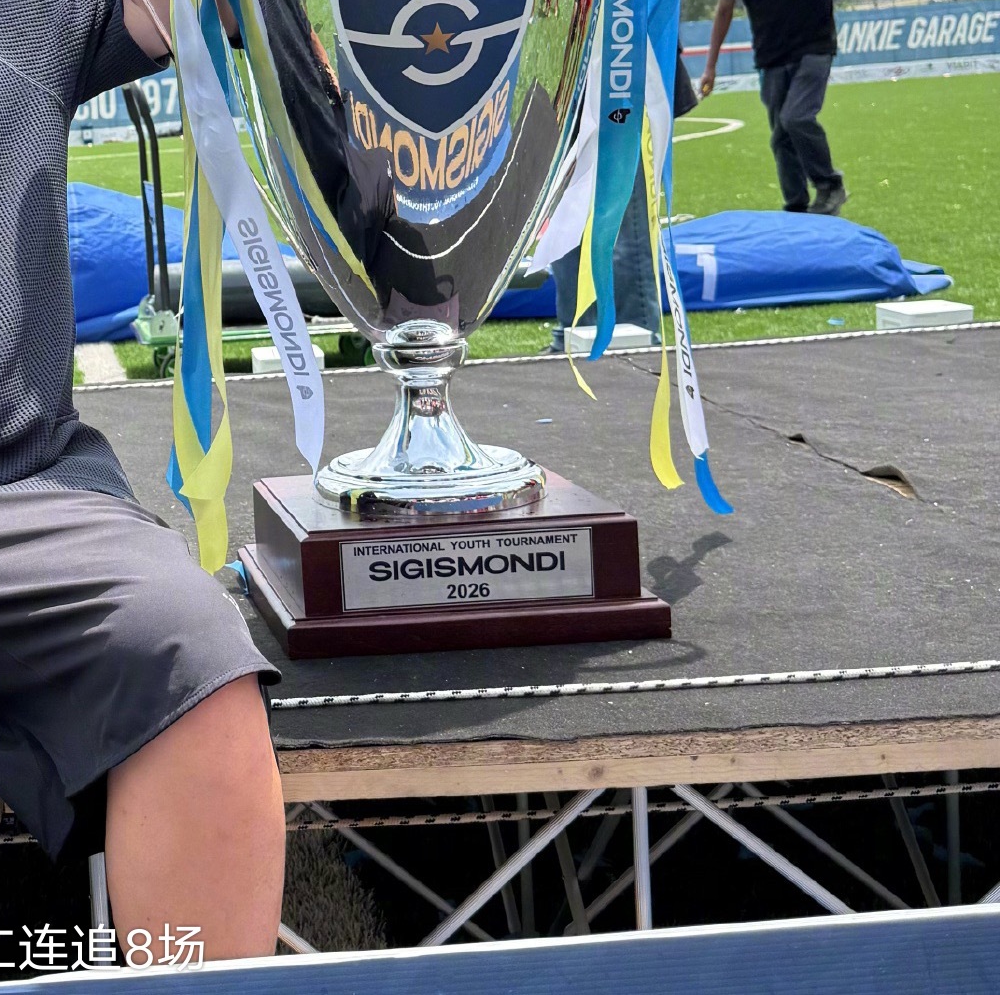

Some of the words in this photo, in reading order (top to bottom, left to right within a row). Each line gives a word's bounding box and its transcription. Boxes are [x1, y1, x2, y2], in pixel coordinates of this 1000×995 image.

[837, 18, 906, 54] ANKIE
[907, 10, 1000, 49] GARAGE
[137, 77, 179, 117] 97
[353, 542, 445, 557] INTERNATIONAL
[450, 539, 491, 551] YOUTH
[496, 533, 578, 548] TOURNAMENT
[368, 551, 566, 582] SIGISMONDI
[446, 582, 491, 600] 2026
